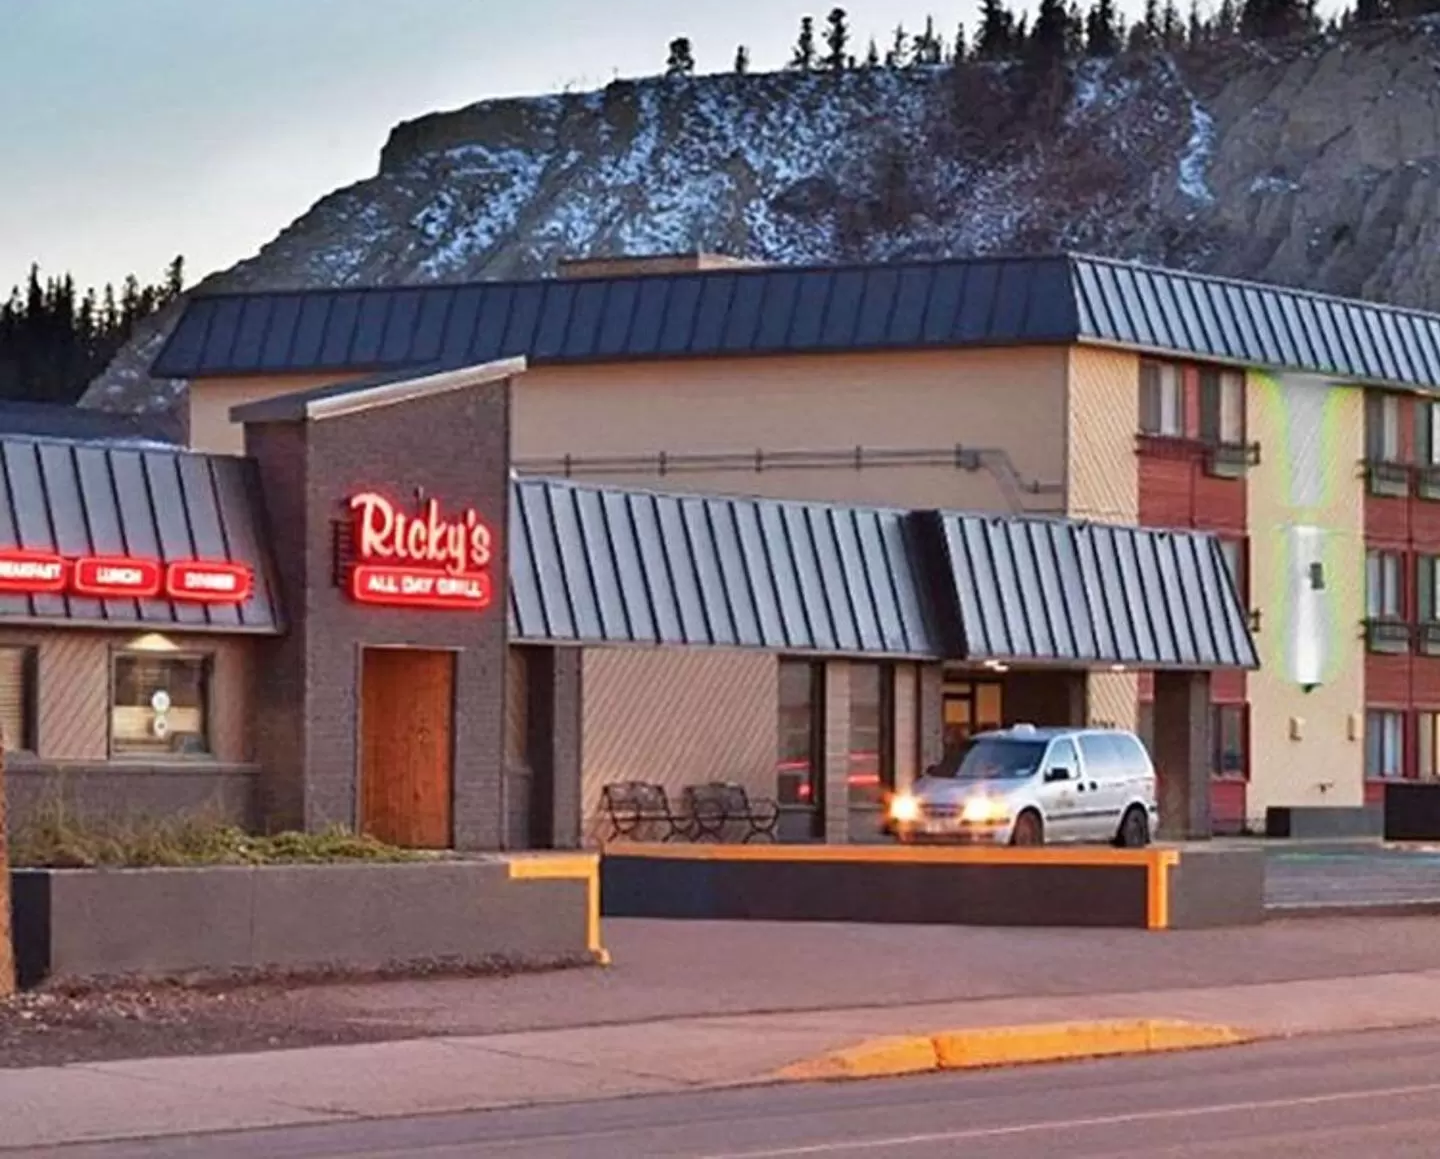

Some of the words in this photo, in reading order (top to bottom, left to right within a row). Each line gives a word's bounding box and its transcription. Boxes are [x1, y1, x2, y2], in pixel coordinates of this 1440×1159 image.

[351, 492, 491, 577] Ricky's
[368, 575, 399, 593] ALL
[402, 576, 434, 594] DAY
[437, 578, 482, 598] GRILL
